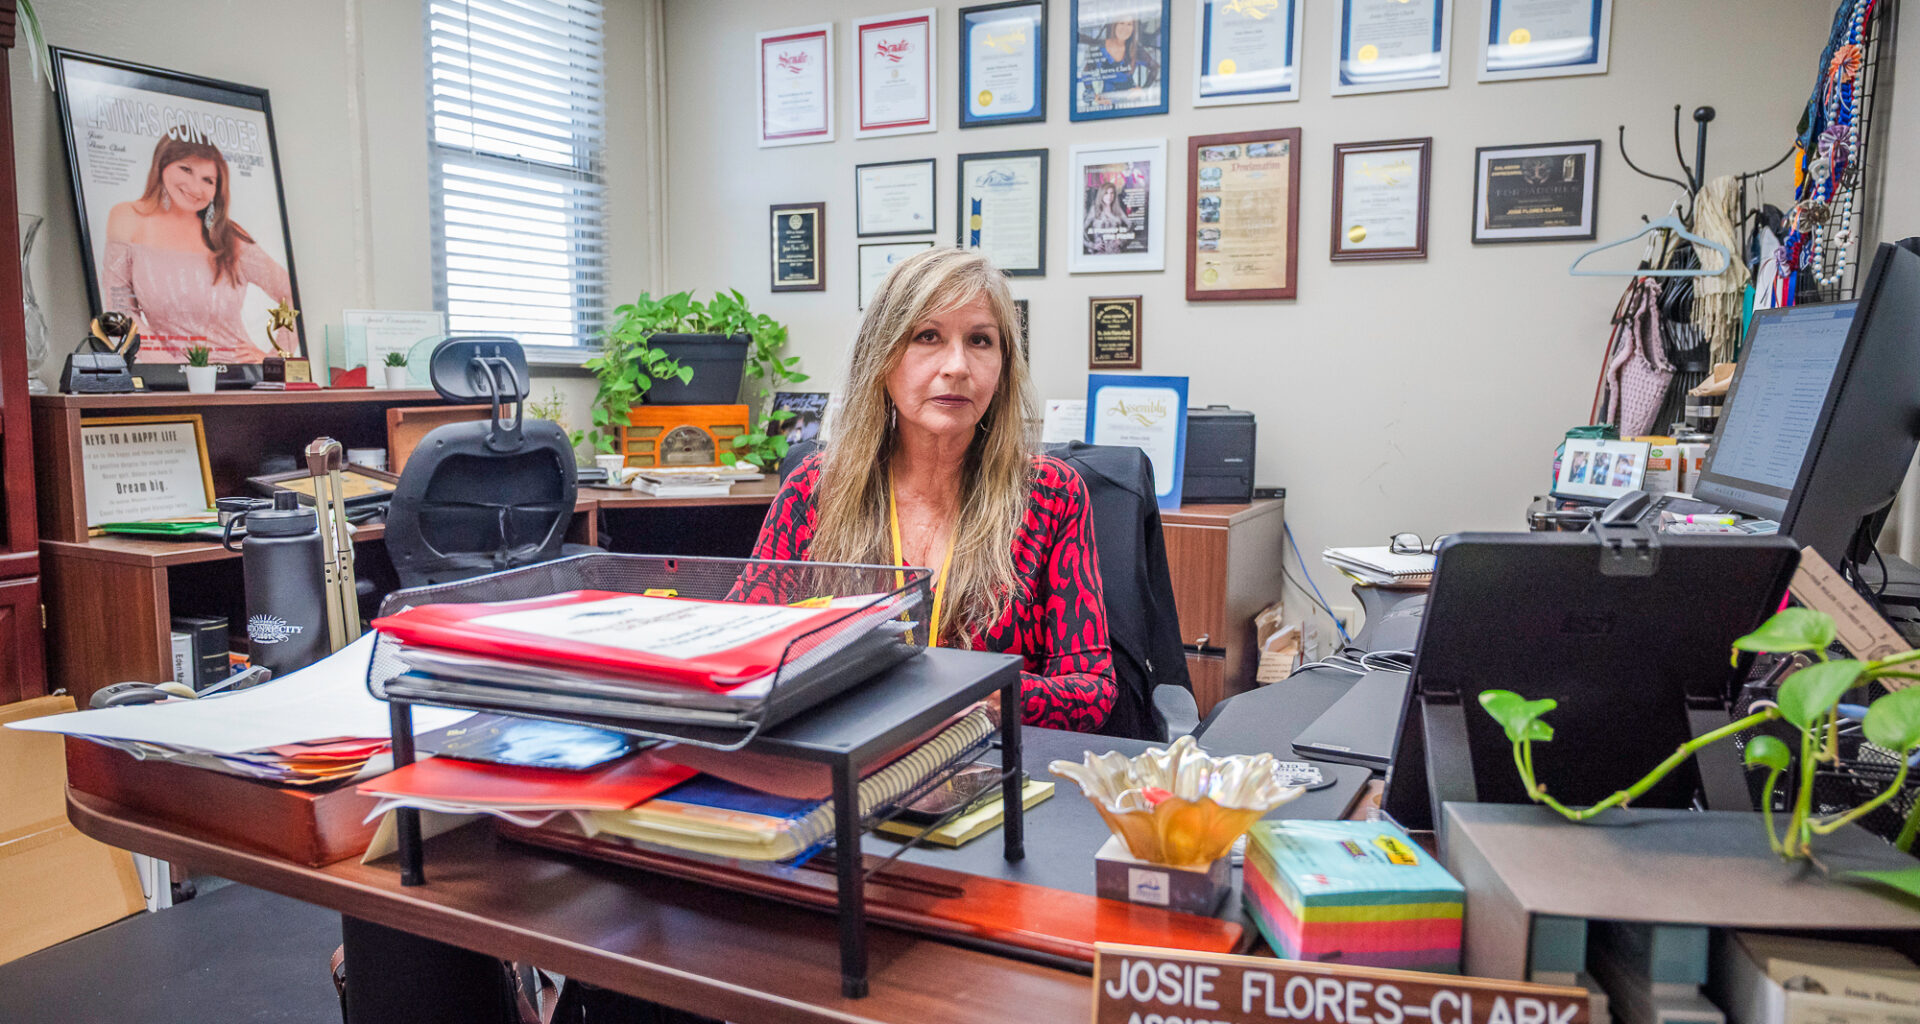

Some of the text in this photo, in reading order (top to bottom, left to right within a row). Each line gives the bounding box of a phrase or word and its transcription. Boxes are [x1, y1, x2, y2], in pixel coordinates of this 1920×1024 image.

[86, 94, 262, 153] LATINAS CON PODER
[1107, 399, 1167, 417] Assembly
[85, 430, 177, 446] KEYS TO A HAPPY LIFE
[116, 479, 169, 494] Dream big.
[279, 625, 304, 634] CITY
[175, 653, 183, 671] Eden
[1105, 958, 1579, 1024] JOSIE FLORES-CLARK
